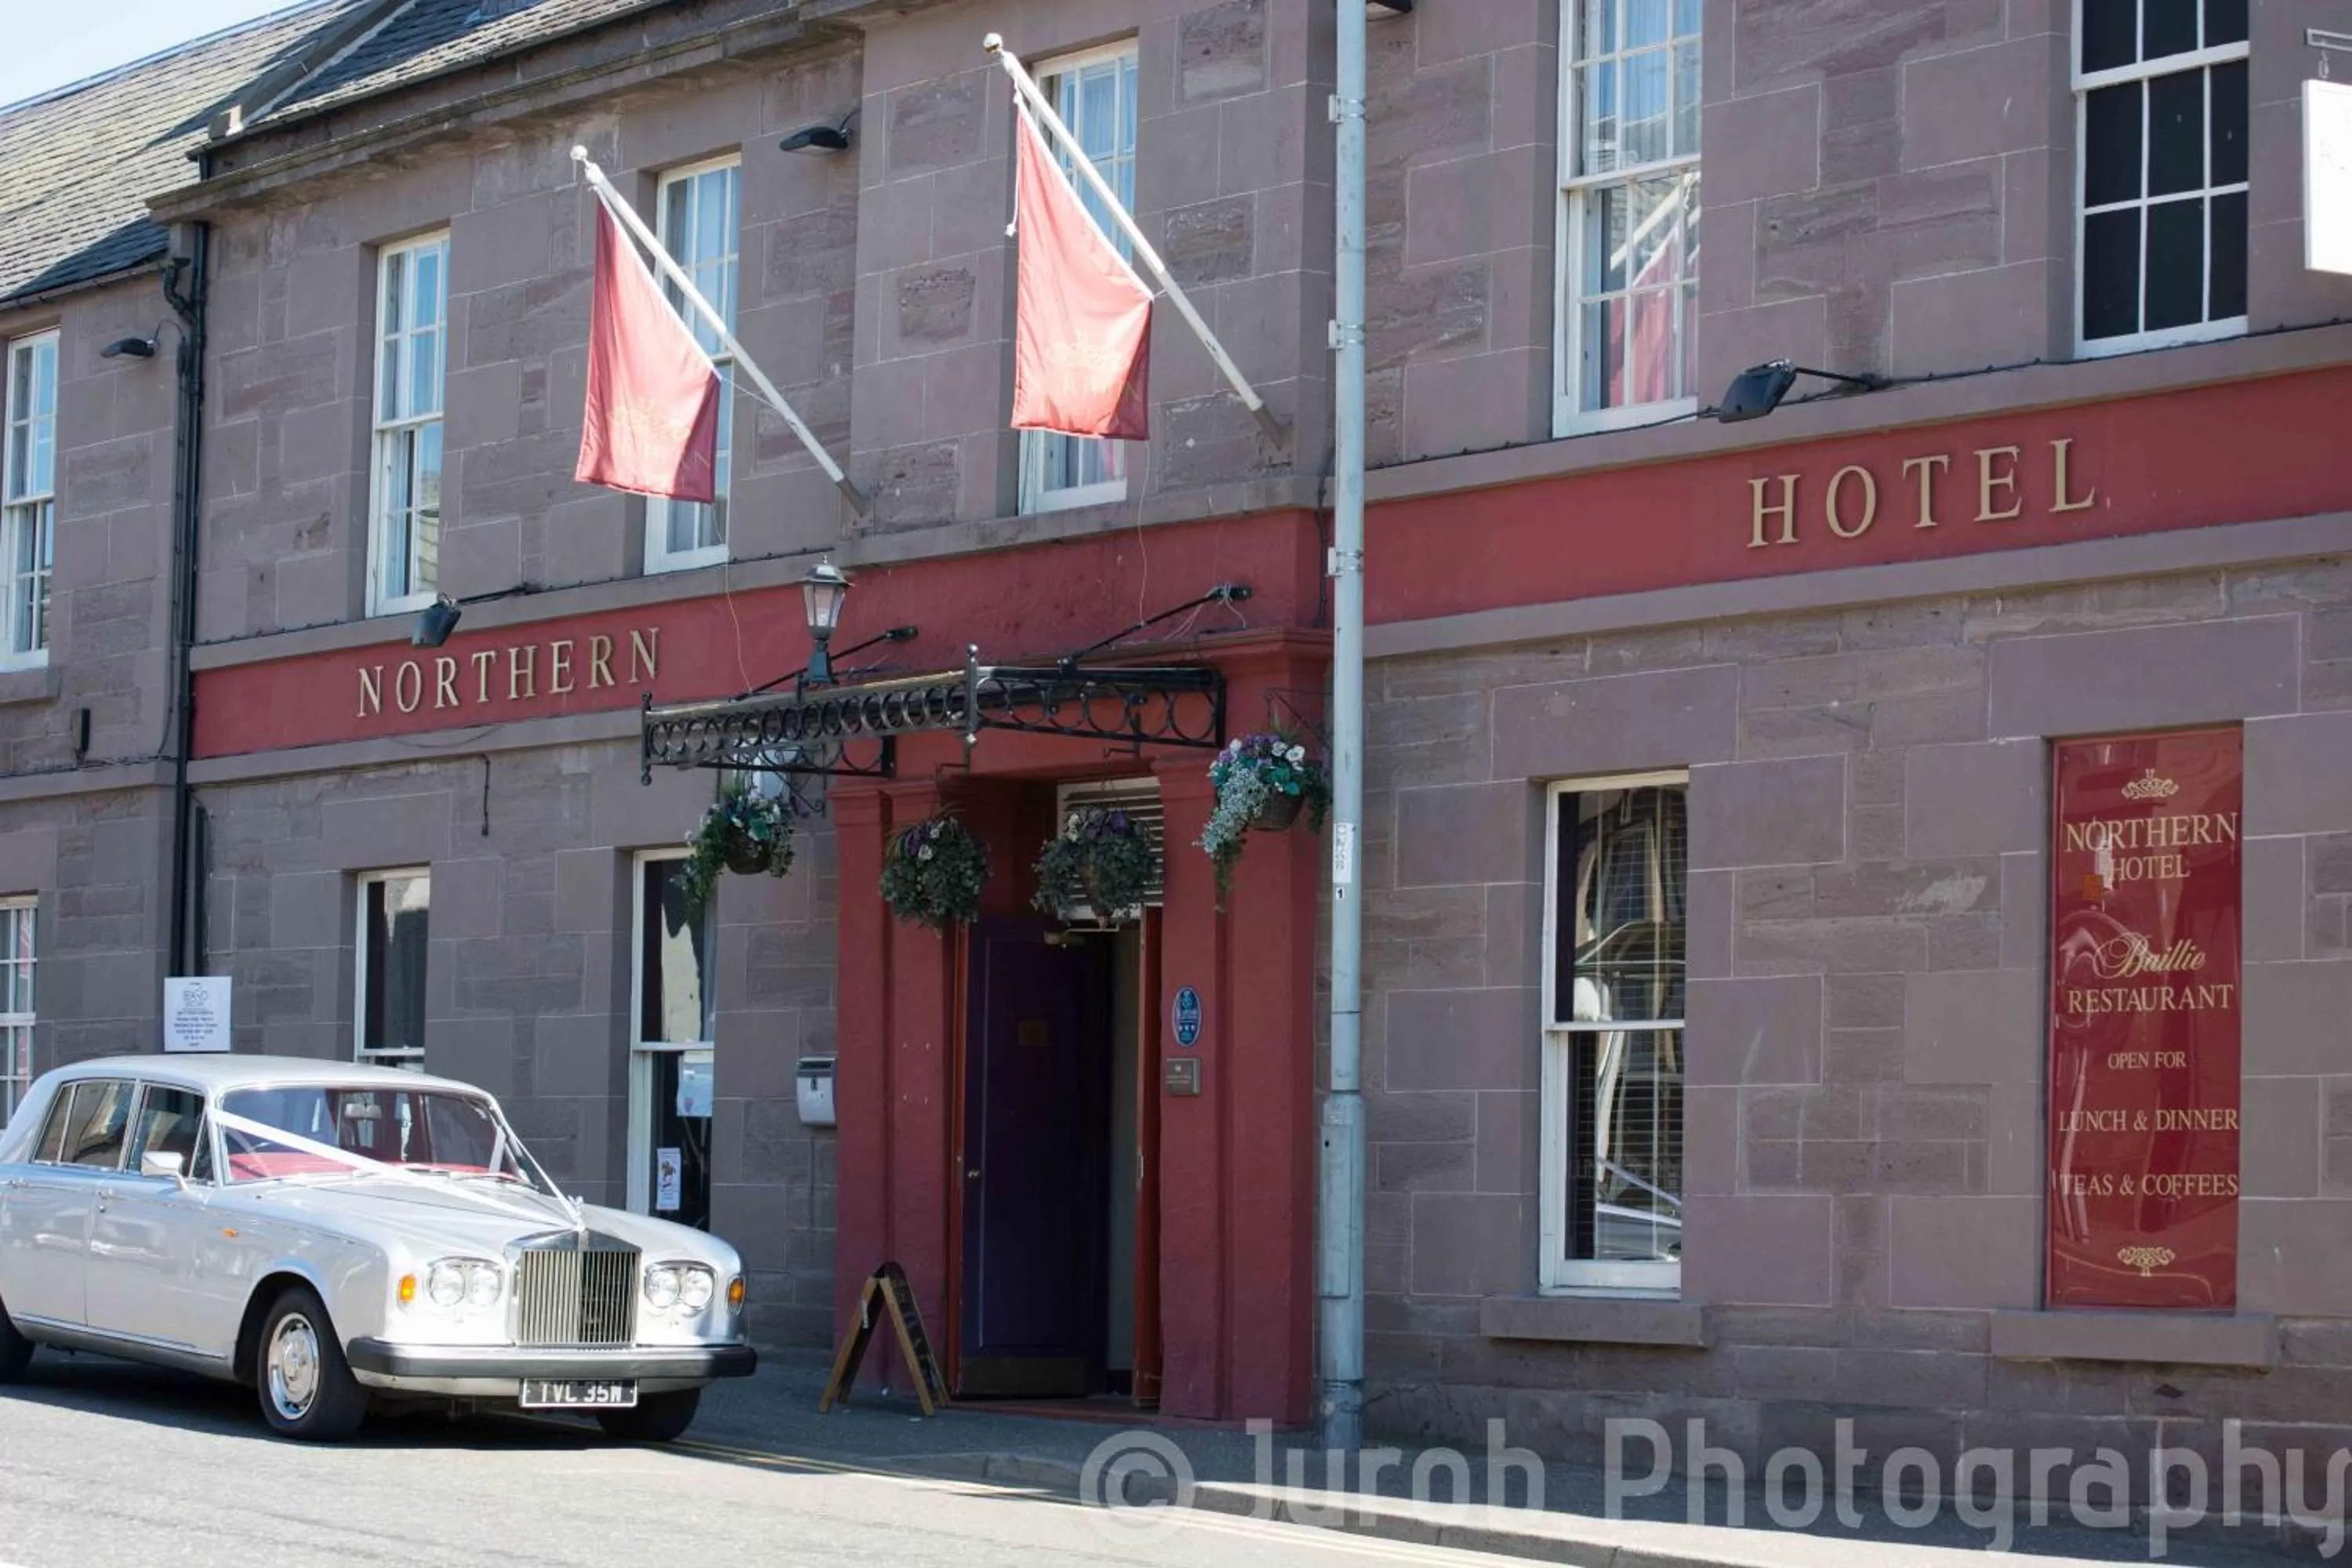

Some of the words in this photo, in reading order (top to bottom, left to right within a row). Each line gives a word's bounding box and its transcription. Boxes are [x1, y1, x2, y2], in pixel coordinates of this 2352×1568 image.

[1747, 437, 2096, 549] HOTEL
[357, 626, 660, 717] NORTHERN
[2064, 812, 2238, 853] NORTHERN
[2111, 854, 2191, 882] HOTEL
[2092, 931, 2206, 979] Baillie
[2067, 984, 2234, 1014] RESTAURANT
[2107, 1052, 2149, 1069] OPEN
[2154, 1051, 2187, 1069] FOR
[2059, 1109, 2127, 1132] LUNCH
[2133, 1112, 2149, 1131] &
[2156, 1109, 2239, 1131] DINNER
[2061, 1174, 2114, 1196] TEAS
[2118, 1176, 2135, 1196] &
[2142, 1174, 2239, 1196] COFFEES
[539, 1381, 578, 1403] TVL
